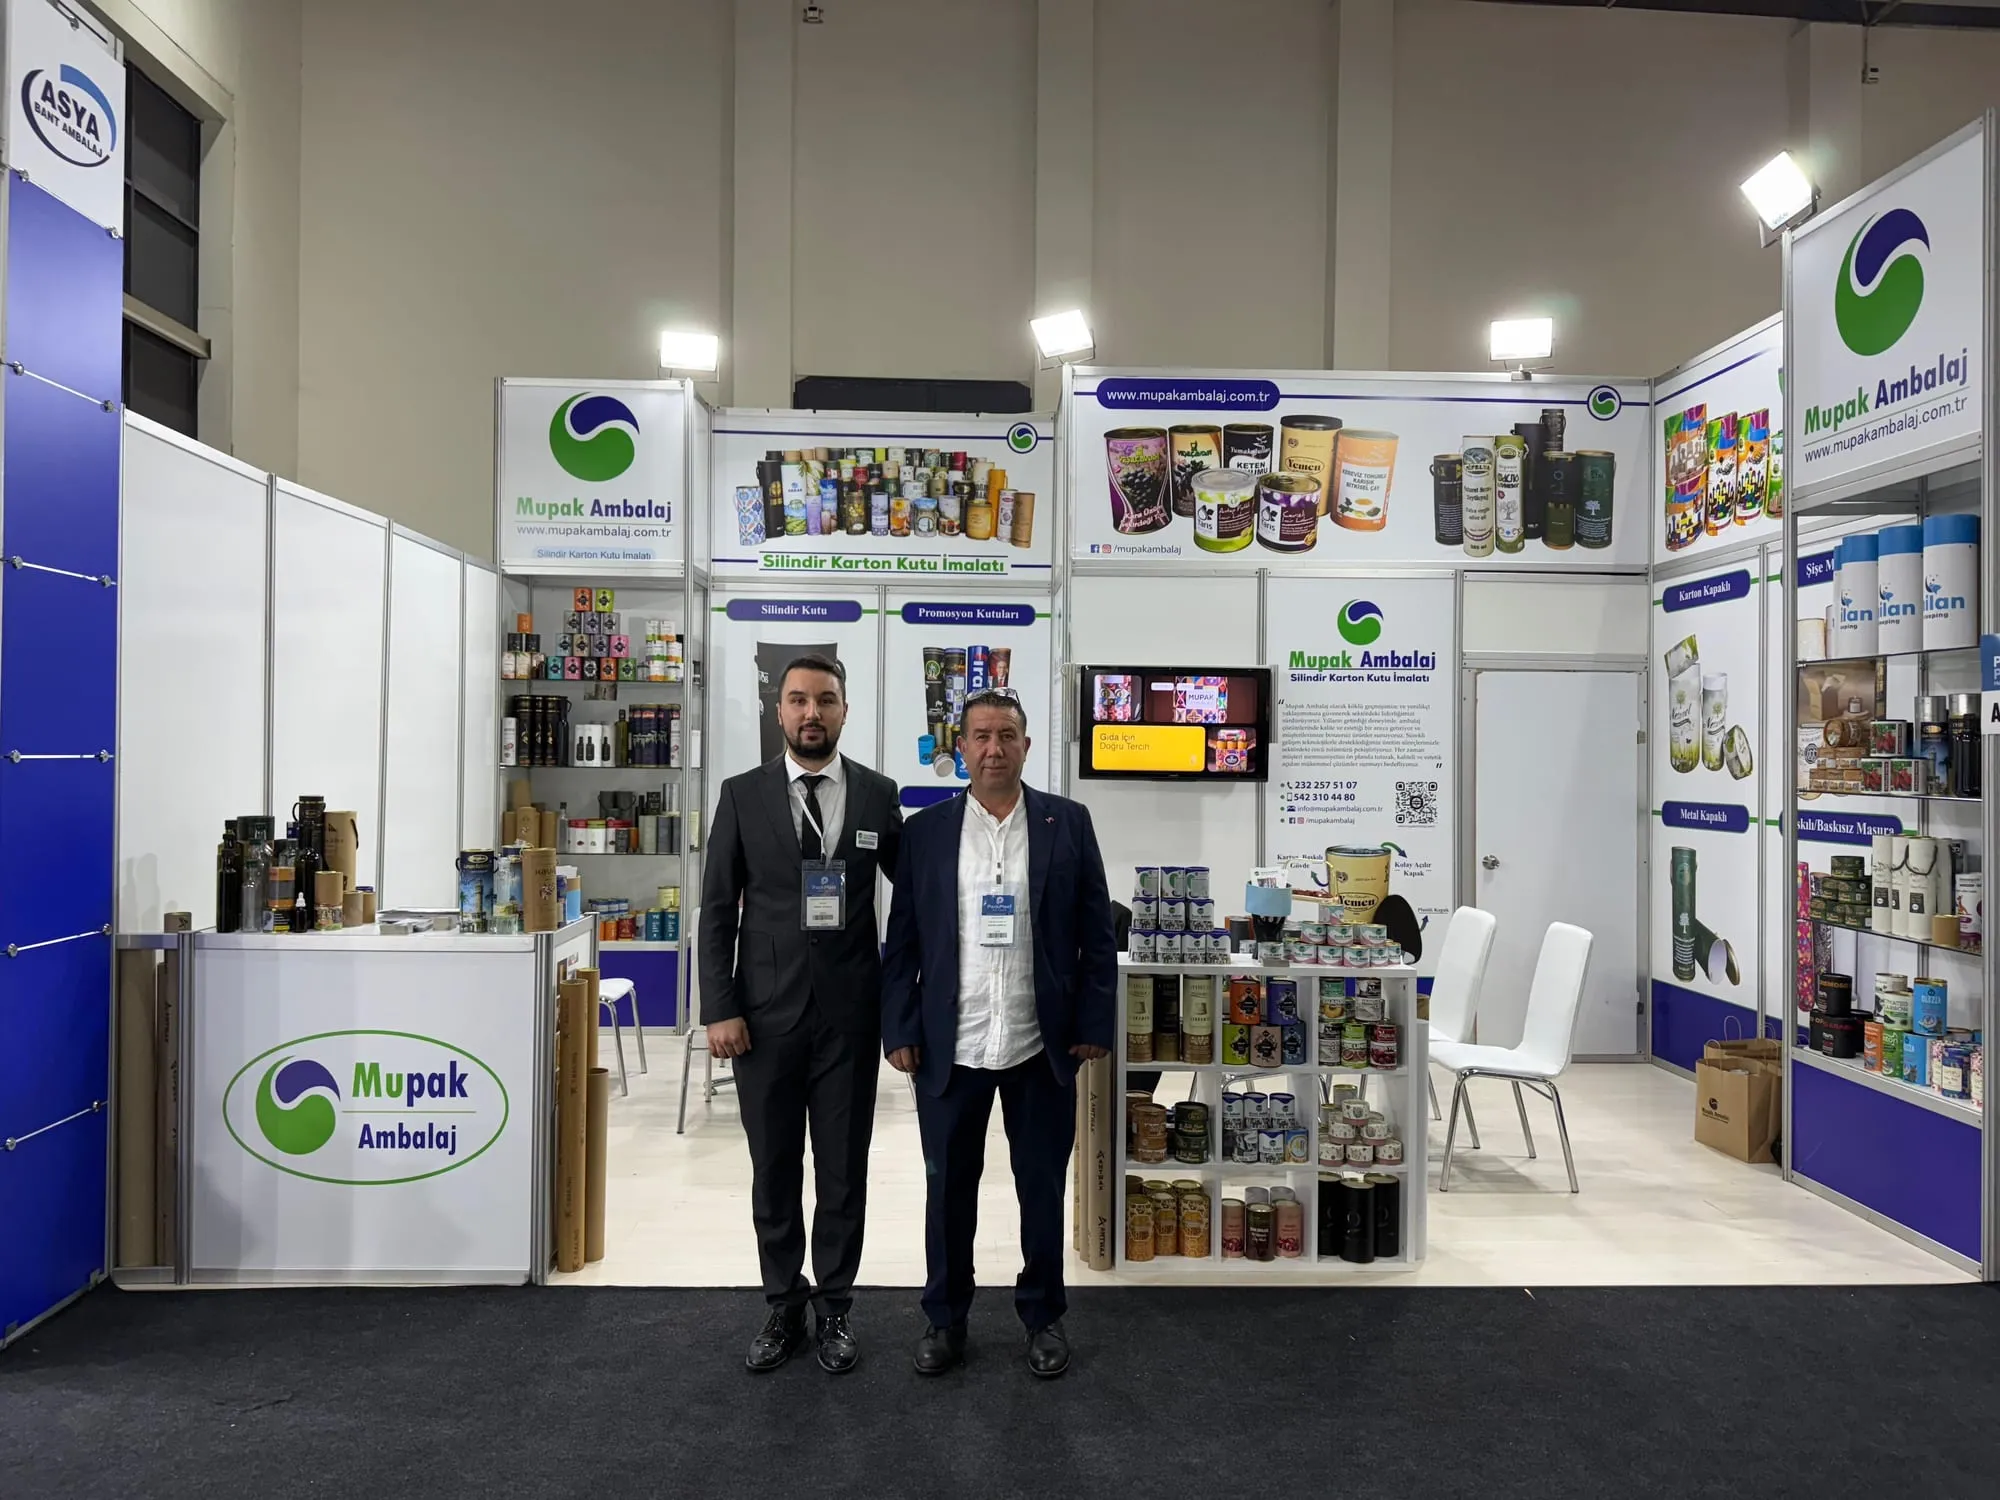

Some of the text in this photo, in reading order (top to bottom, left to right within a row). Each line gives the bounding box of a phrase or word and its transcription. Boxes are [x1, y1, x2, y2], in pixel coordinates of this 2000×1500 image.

[41, 79, 100, 142] ASYA
[34, 103, 103, 158] BANT AMBALAJ
[1106, 389, 1270, 403] www.mupakambalaj.com.tr
[1804, 347, 1968, 435] Mupak Ambalaj
[1804, 396, 1968, 463] www.mupakambalaj.com.tr
[1286, 458, 1322, 472] Yemen
[516, 497, 672, 523] Mupak Ambalaj
[517, 525, 672, 539] www.mupakambalaj.com.tr
[537, 549, 651, 560] Silindir Karton Kutu İmalatı
[1113, 544, 1182, 555] /mupakambalaj
[763, 554, 1005, 572] Silindir Karton Kutu İmalatı
[1806, 561, 1823, 578] Şişe
[1679, 580, 1731, 602] Karton Kapaklı
[761, 604, 828, 615] Silindir Kutu
[918, 607, 1020, 620] Promosyon Kutuları
[1289, 650, 1436, 672] Mupak Ambalaj
[1290, 672, 1430, 682] Silindir Karton Kutu İmalatı
[1100, 741, 1124, 751] Doğru
[1294, 781, 1358, 789] 232 257 51 07
[1294, 793, 1356, 801] 542 310 44 80
[1297, 805, 1383, 813] info@mupakambalaj.com.tr
[1680, 808, 1727, 824] Metal Kapaklı
[1306, 817, 1355, 825] /mupakambalaj
[1394, 861, 1413, 870] Kolay
[1403, 870, 1425, 878] Kapak
[1339, 895, 1375, 907] Yemen
[352, 1060, 468, 1107] Mupak
[358, 1122, 457, 1155] Ambalaj
